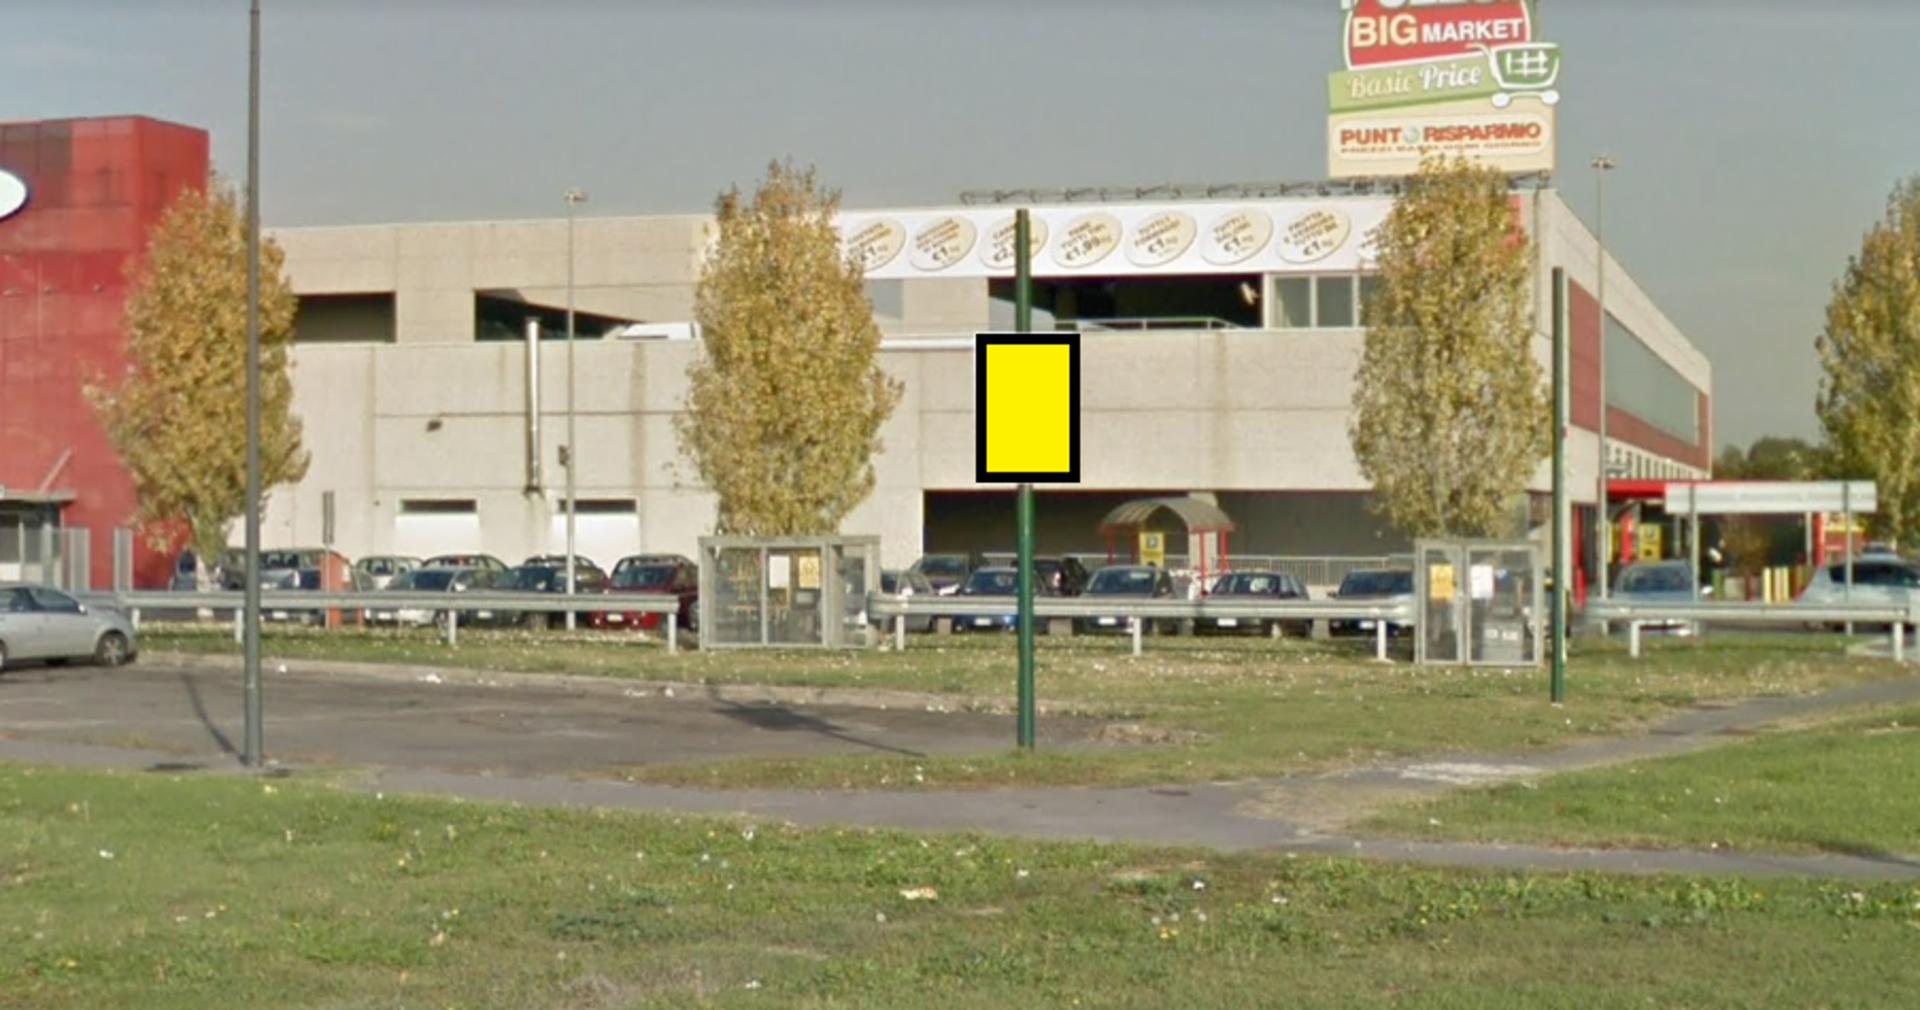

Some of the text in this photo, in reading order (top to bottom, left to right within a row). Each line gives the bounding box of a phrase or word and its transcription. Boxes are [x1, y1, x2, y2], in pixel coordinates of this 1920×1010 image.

[1352, 14, 1523, 47] BIG MARKET
[1347, 63, 1481, 98] Basic Price
[1423, 122, 1541, 142] RISPARMIO
